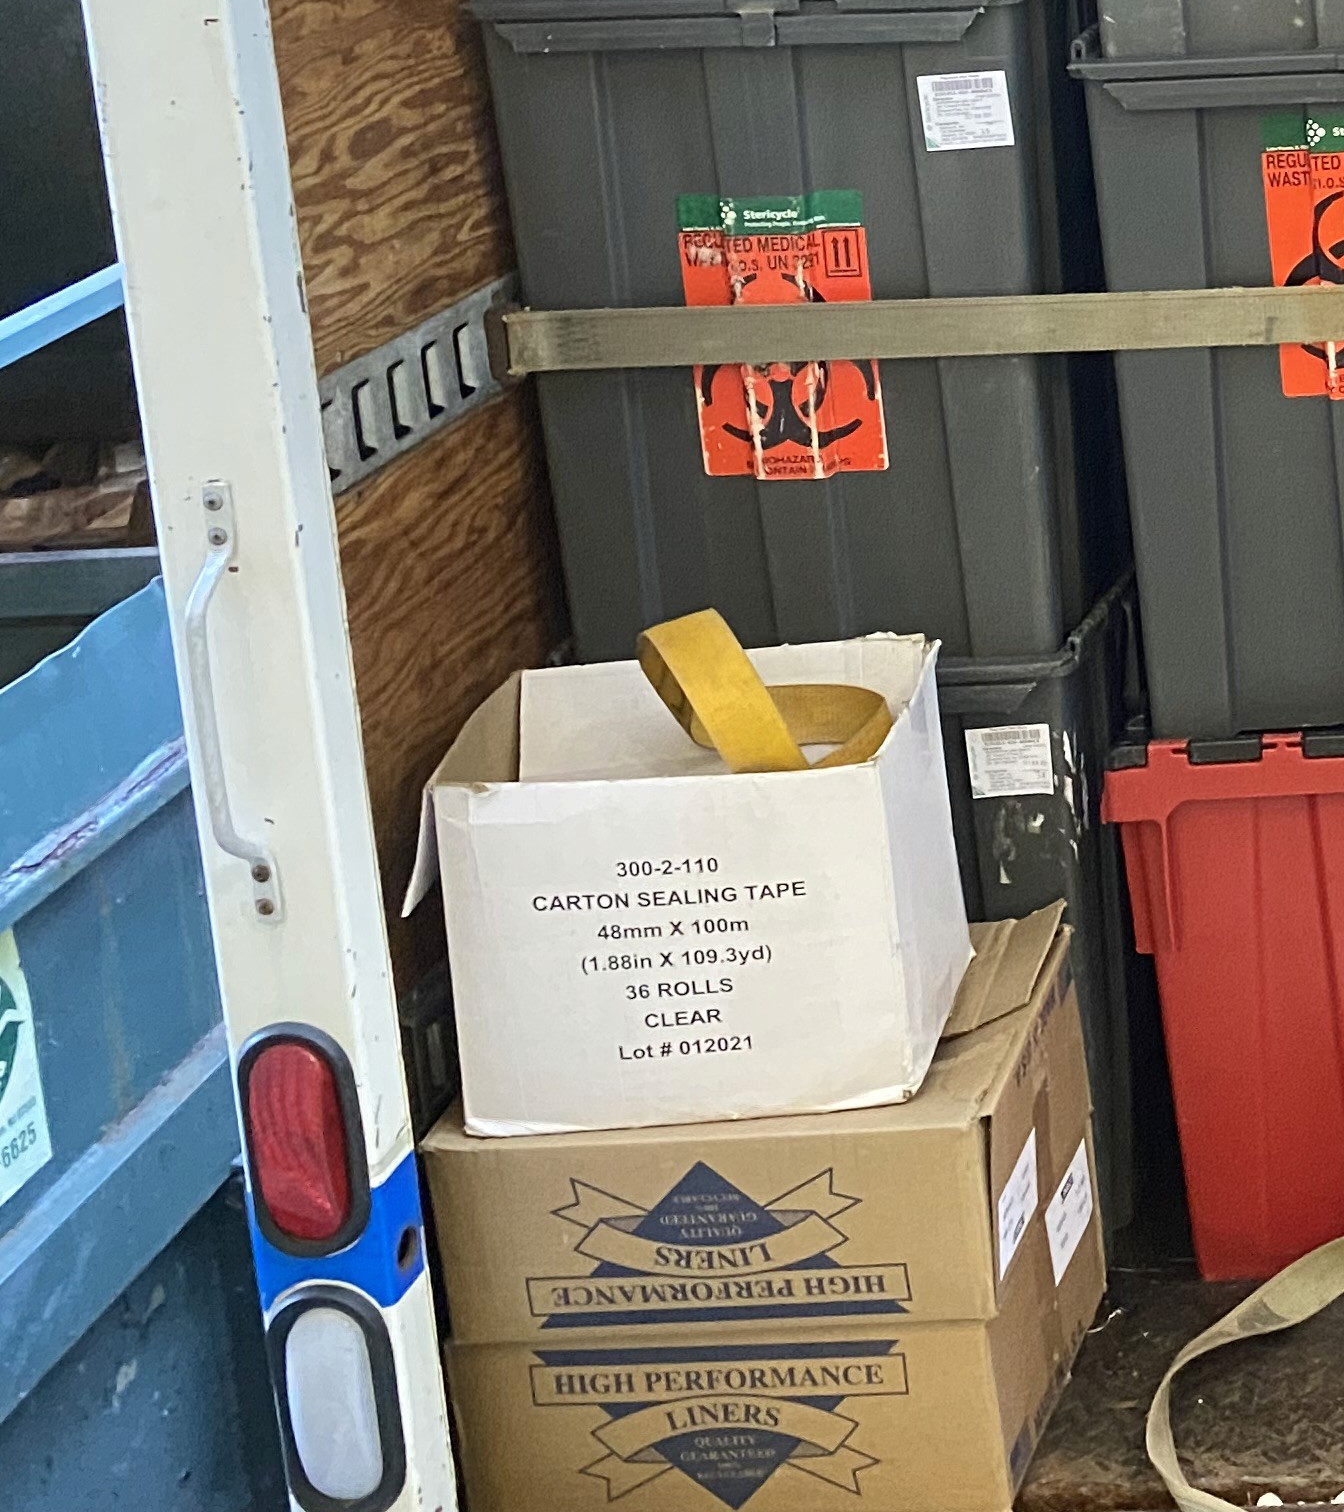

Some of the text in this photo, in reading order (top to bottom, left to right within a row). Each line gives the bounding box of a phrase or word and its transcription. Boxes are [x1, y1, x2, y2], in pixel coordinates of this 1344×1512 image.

[743, 209, 799, 221] Stericycle
[758, 233, 821, 253] MEDICAL
[767, 255, 788, 270] UN
[616, 857, 719, 878] 300-2-110
[532, 880, 807, 913] CARTON SEALING TAPE
[597, 916, 749, 941] 48mm X 100m
[581, 944, 772, 976] (1.88in X 109.3yd)
[626, 977, 734, 1000] 36 ROLLS
[645, 1007, 723, 1029] CLEAR
[618, 1035, 753, 1060] Lot # 012021
[680, 1224, 743, 1239] QUALITY
[654, 1240, 773, 1271] LINERS
[550, 1272, 886, 1307] HIGH PERFORMANCE
[554, 1361, 884, 1395] HIGH PERFORMANCE
[664, 1401, 781, 1431] LINERS
[693, 1433, 756, 1448] QUALITY
